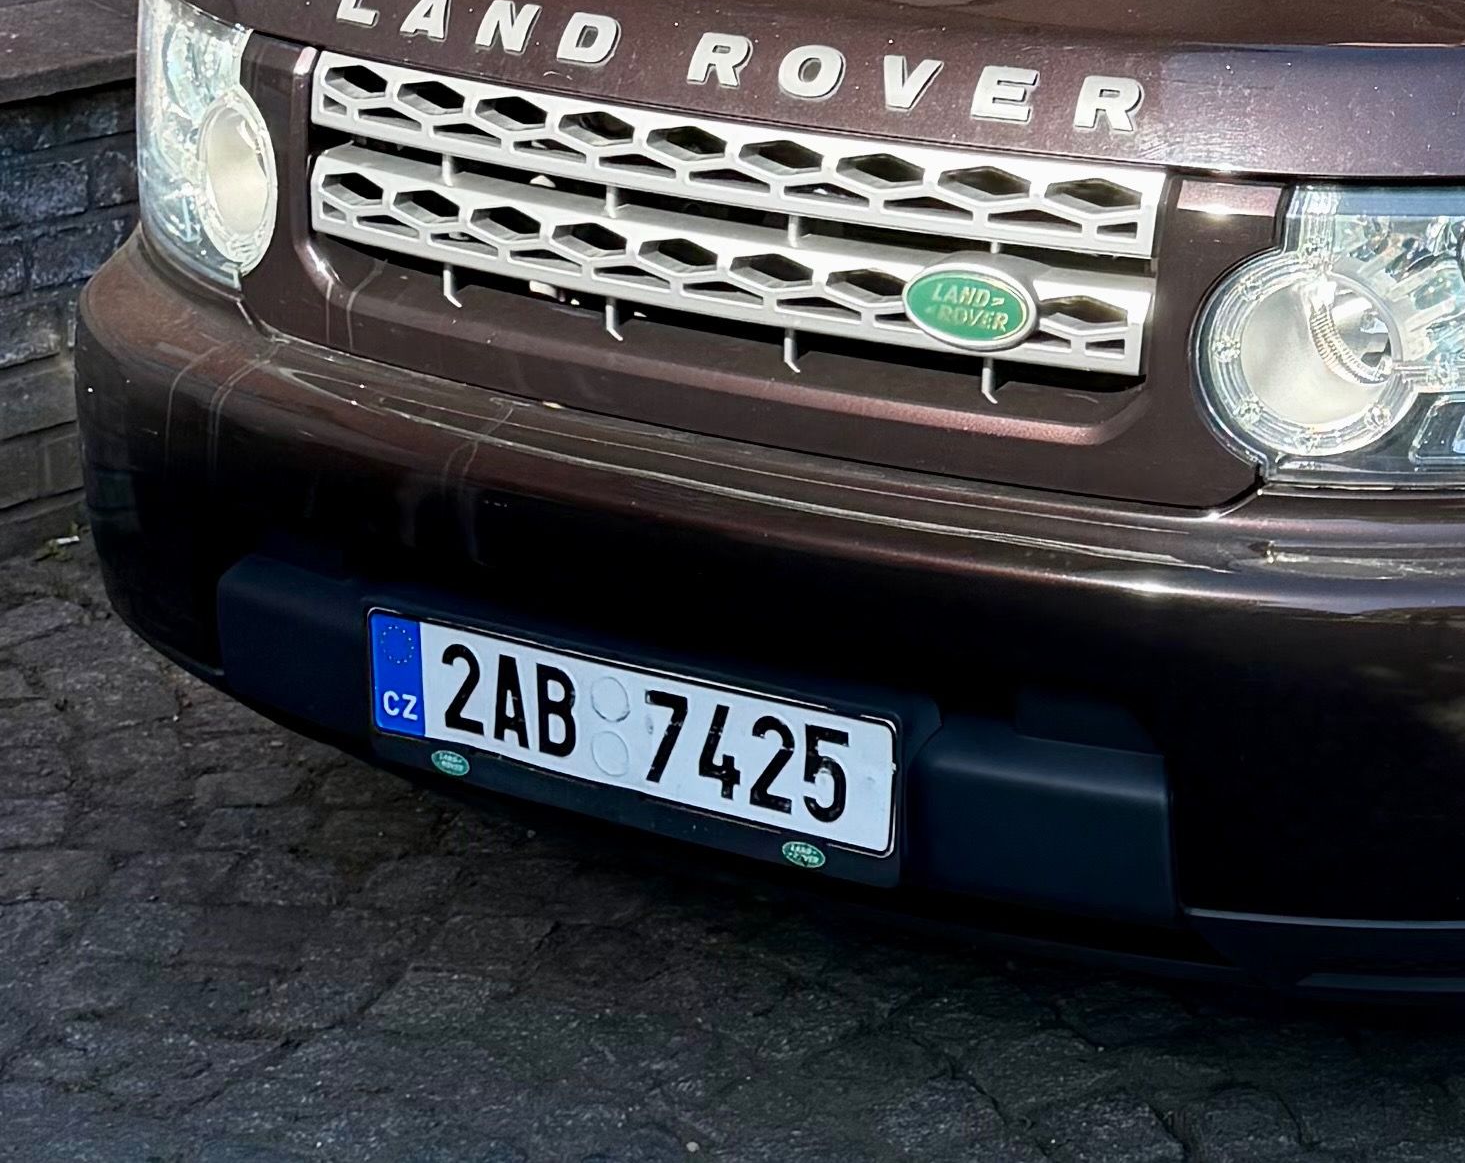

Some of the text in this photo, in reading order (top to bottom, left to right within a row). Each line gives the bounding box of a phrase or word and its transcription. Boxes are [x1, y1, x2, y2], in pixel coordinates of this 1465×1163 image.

[686, 32, 1145, 132] ROVER
[930, 283, 991, 308] LAND
[936, 304, 1010, 333] ROVER
[381, 688, 419, 722] CZ
[441, 642, 851, 825] 2AB 7425
